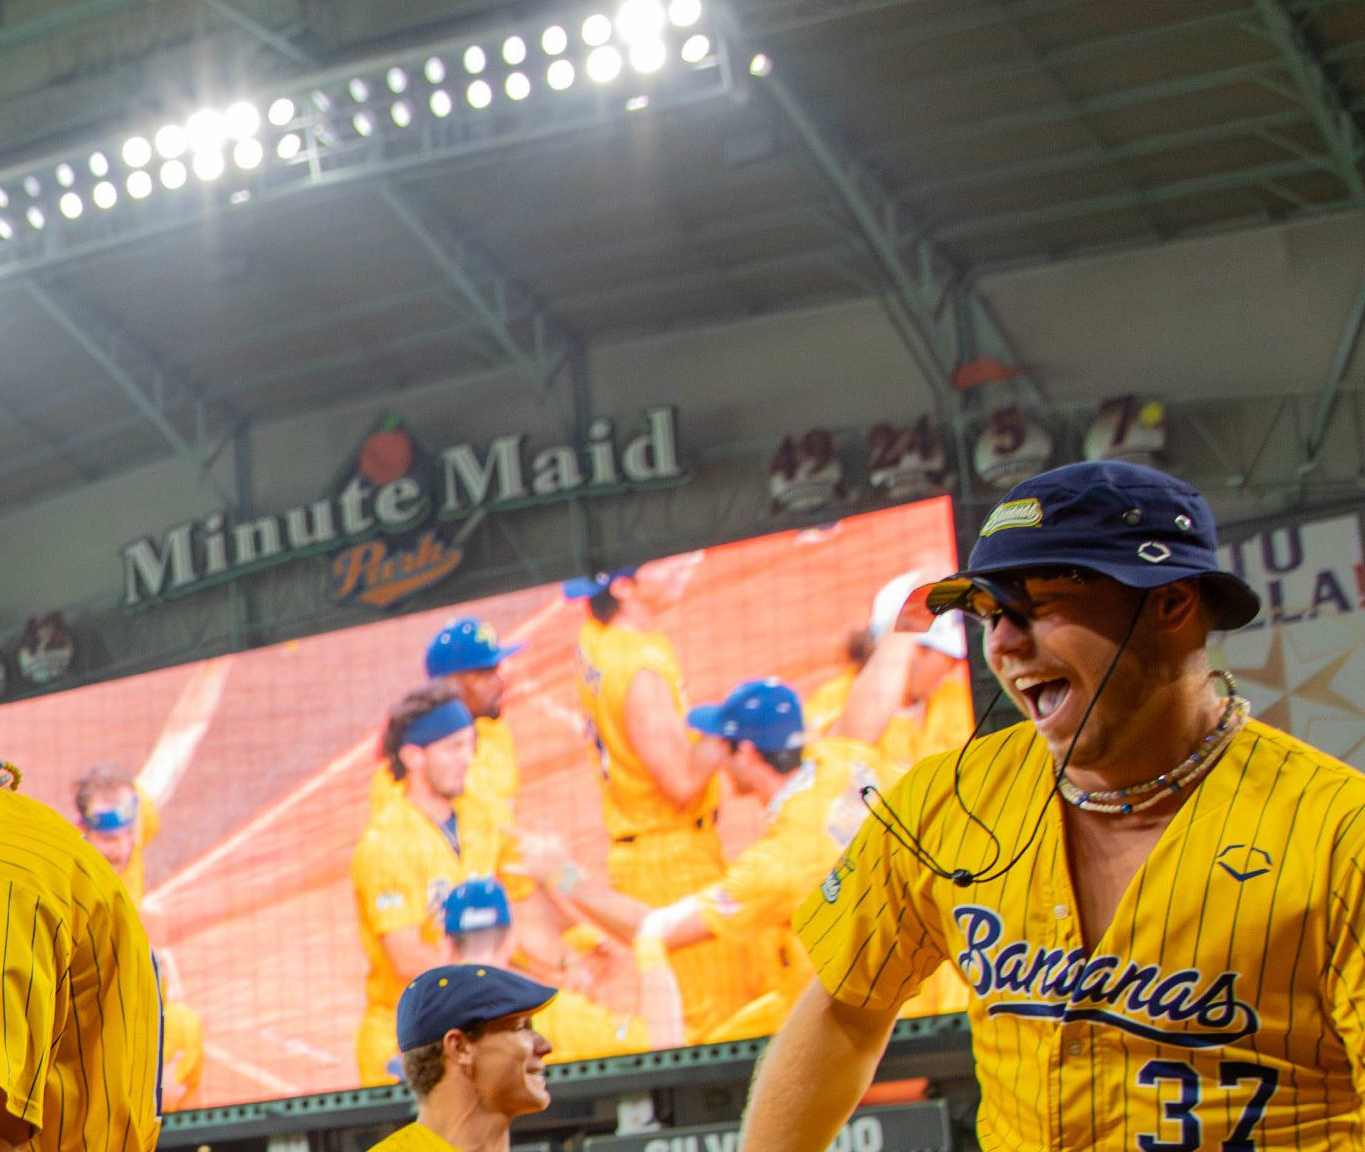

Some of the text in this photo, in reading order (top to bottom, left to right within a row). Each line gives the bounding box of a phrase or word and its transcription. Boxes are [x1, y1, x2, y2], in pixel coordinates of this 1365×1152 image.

[122, 405, 681, 604] Minute Maid
[333, 530, 463, 606] Park
[952, 905, 1260, 1049] Bananas
